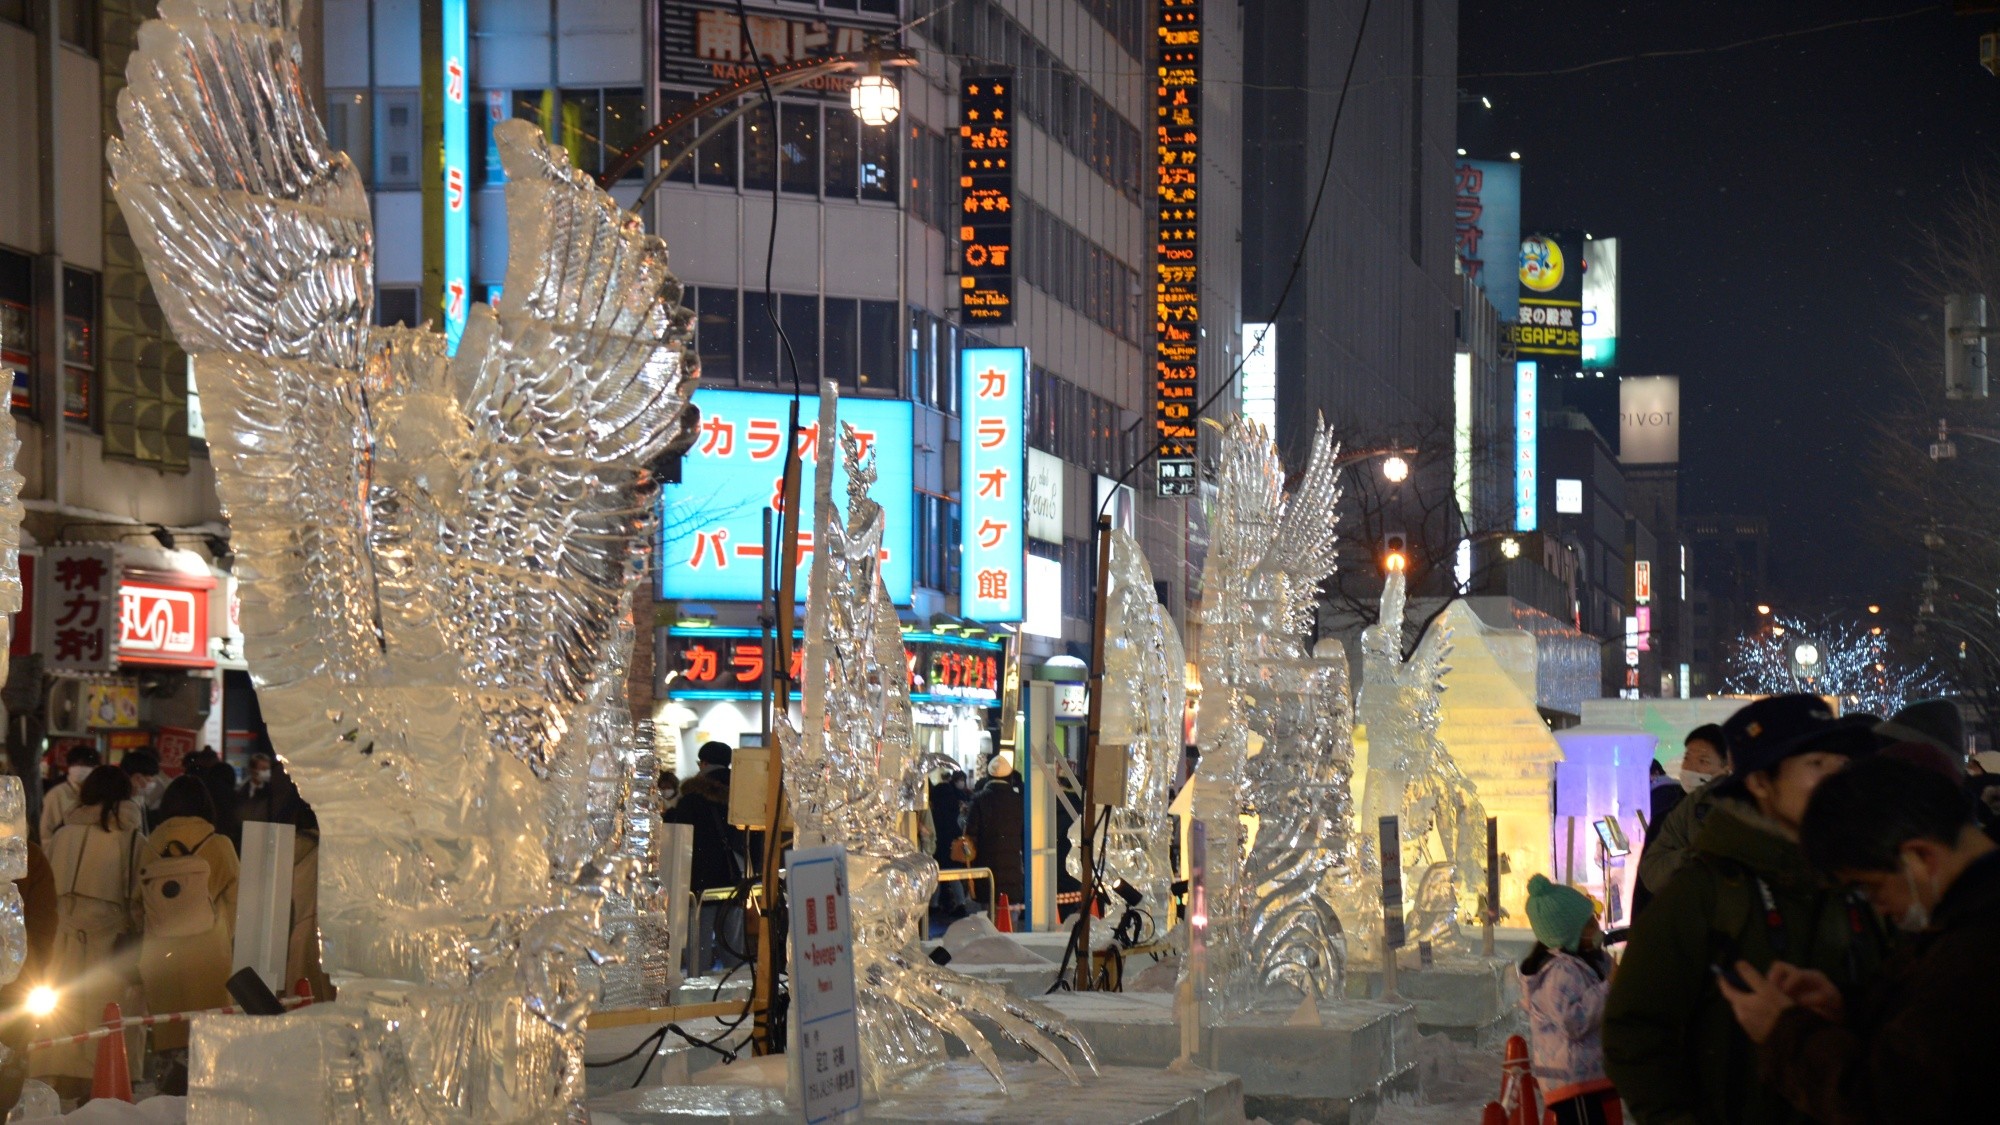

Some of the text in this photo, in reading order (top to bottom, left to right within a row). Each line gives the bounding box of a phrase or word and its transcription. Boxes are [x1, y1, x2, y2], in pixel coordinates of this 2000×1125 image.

[1167, 250, 1193, 259] TOMO
[986, 294, 1009, 305] Palais
[1163, 347, 1196, 355] DOLPHIN
[978, 369, 1008, 599] カラオケ館
[55, 556, 107, 662] 精力剤
